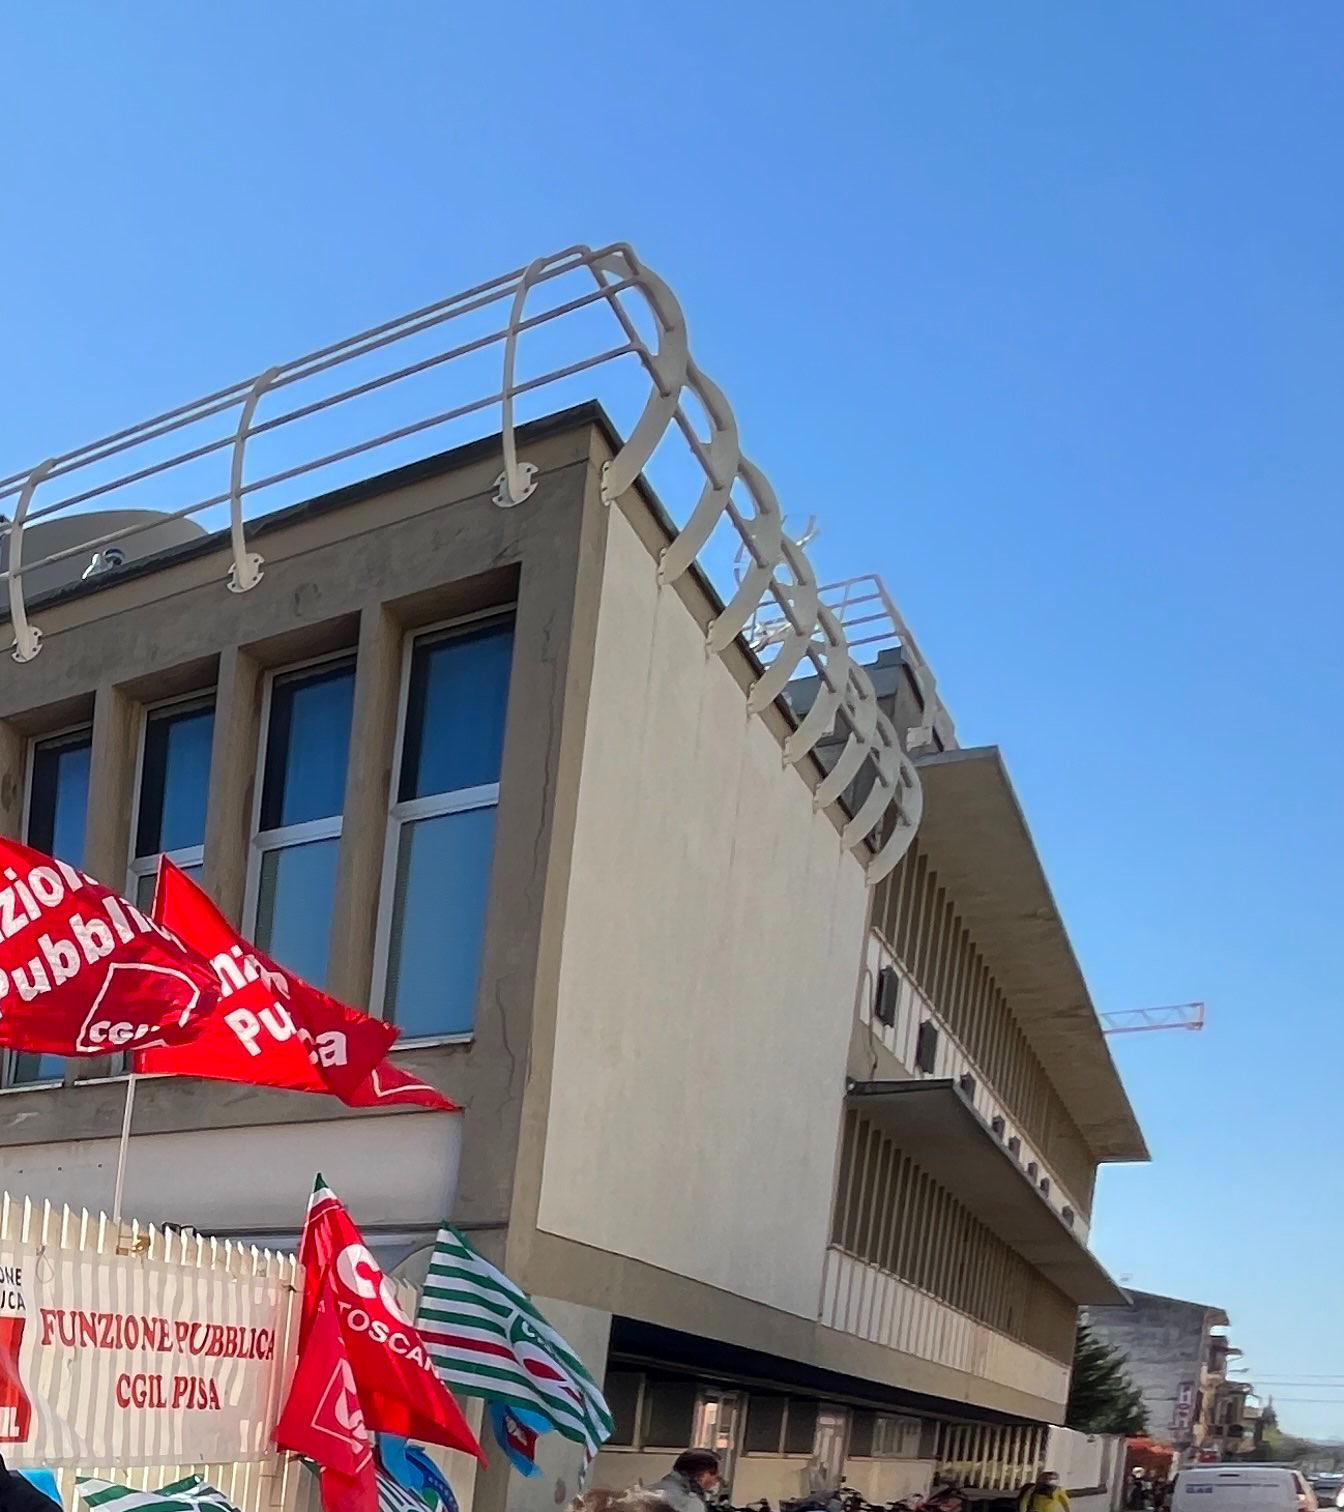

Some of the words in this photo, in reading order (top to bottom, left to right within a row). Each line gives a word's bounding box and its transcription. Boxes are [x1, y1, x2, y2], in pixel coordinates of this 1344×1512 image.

[39, 1308, 172, 1353] FUNZIONE
[115, 1373, 168, 1410] CGIL
[171, 1376, 221, 1411] PISA
